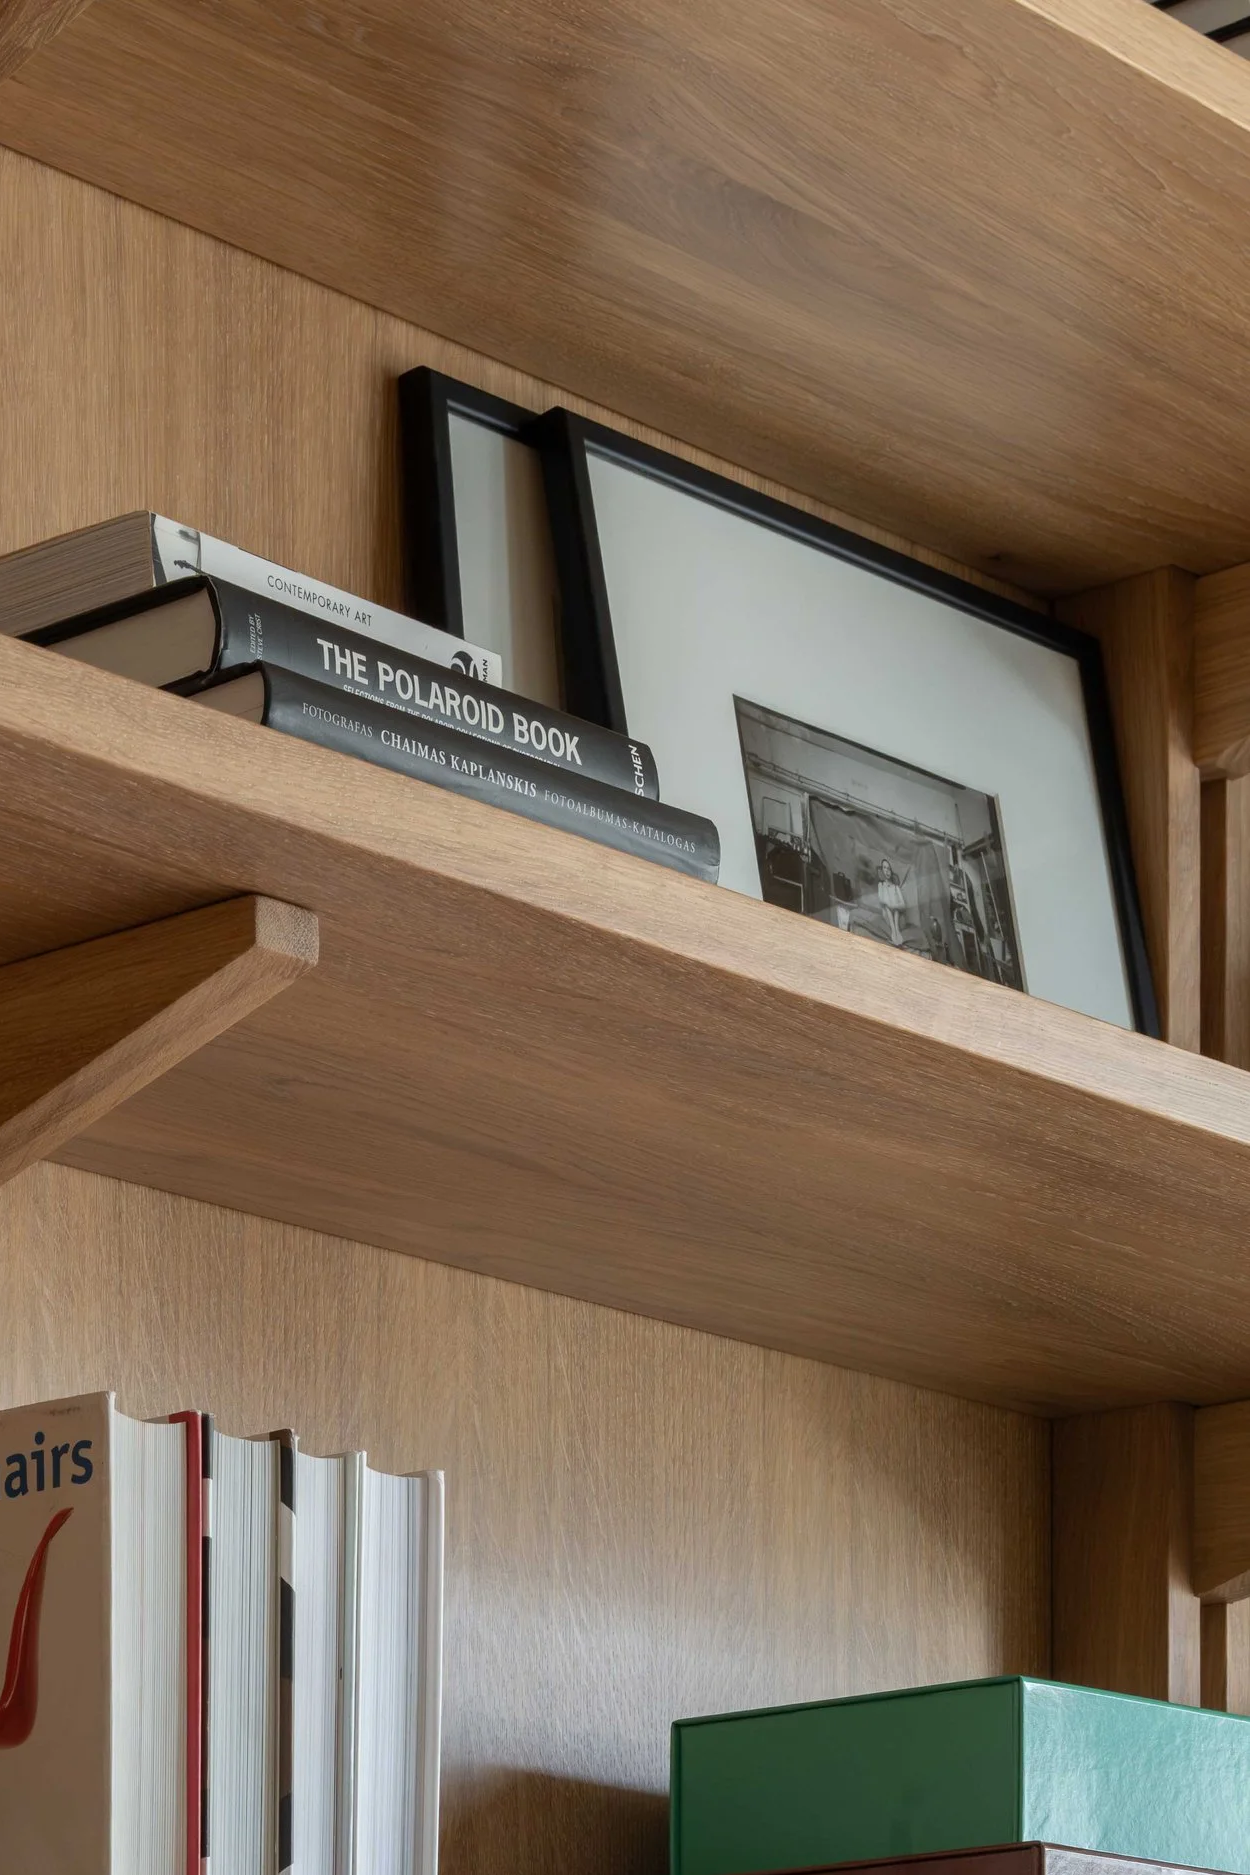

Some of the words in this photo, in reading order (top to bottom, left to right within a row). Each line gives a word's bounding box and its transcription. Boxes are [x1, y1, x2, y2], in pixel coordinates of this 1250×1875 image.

[267, 575, 350, 618] CONTEMPORARY
[354, 611, 372, 627] ART
[317, 637, 369, 685] THE
[377, 661, 504, 734] POLAROID
[512, 712, 583, 766] BOOK
[302, 702, 373, 738] FOTOGRAFAS
[381, 730, 446, 766] CHAIMAS
[450, 754, 537, 798] KAPLANSKIS
[544, 789, 696, 853] FOTOALBUMAS-KATALOGAS
